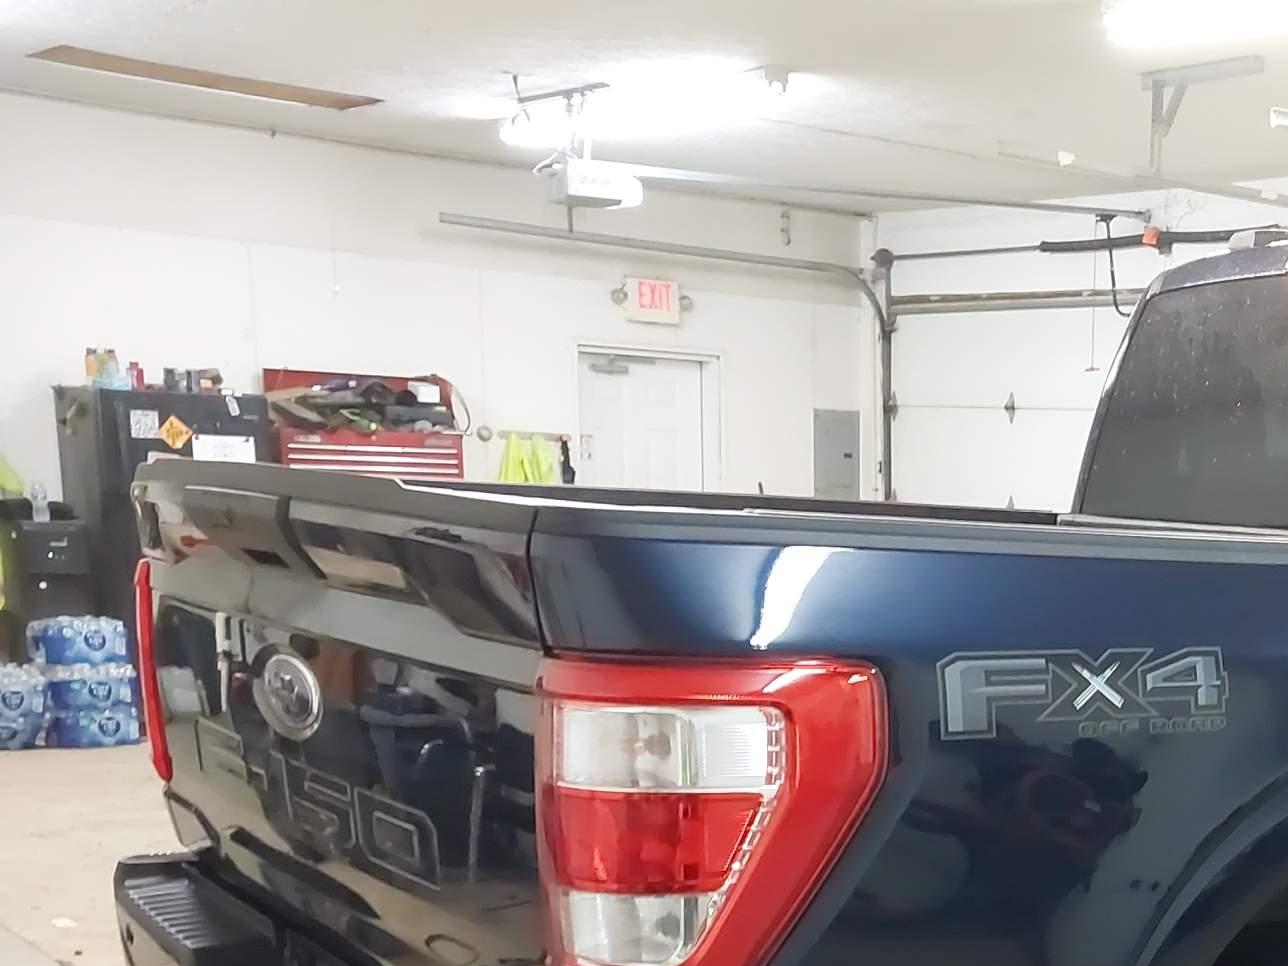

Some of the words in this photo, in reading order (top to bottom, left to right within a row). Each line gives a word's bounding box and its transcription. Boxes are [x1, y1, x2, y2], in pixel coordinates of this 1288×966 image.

[638, 281, 672, 310] EXIT
[936, 646, 1230, 741] FX4
[1077, 719, 1140, 738] OFF
[1149, 715, 1227, 735] ROAD
